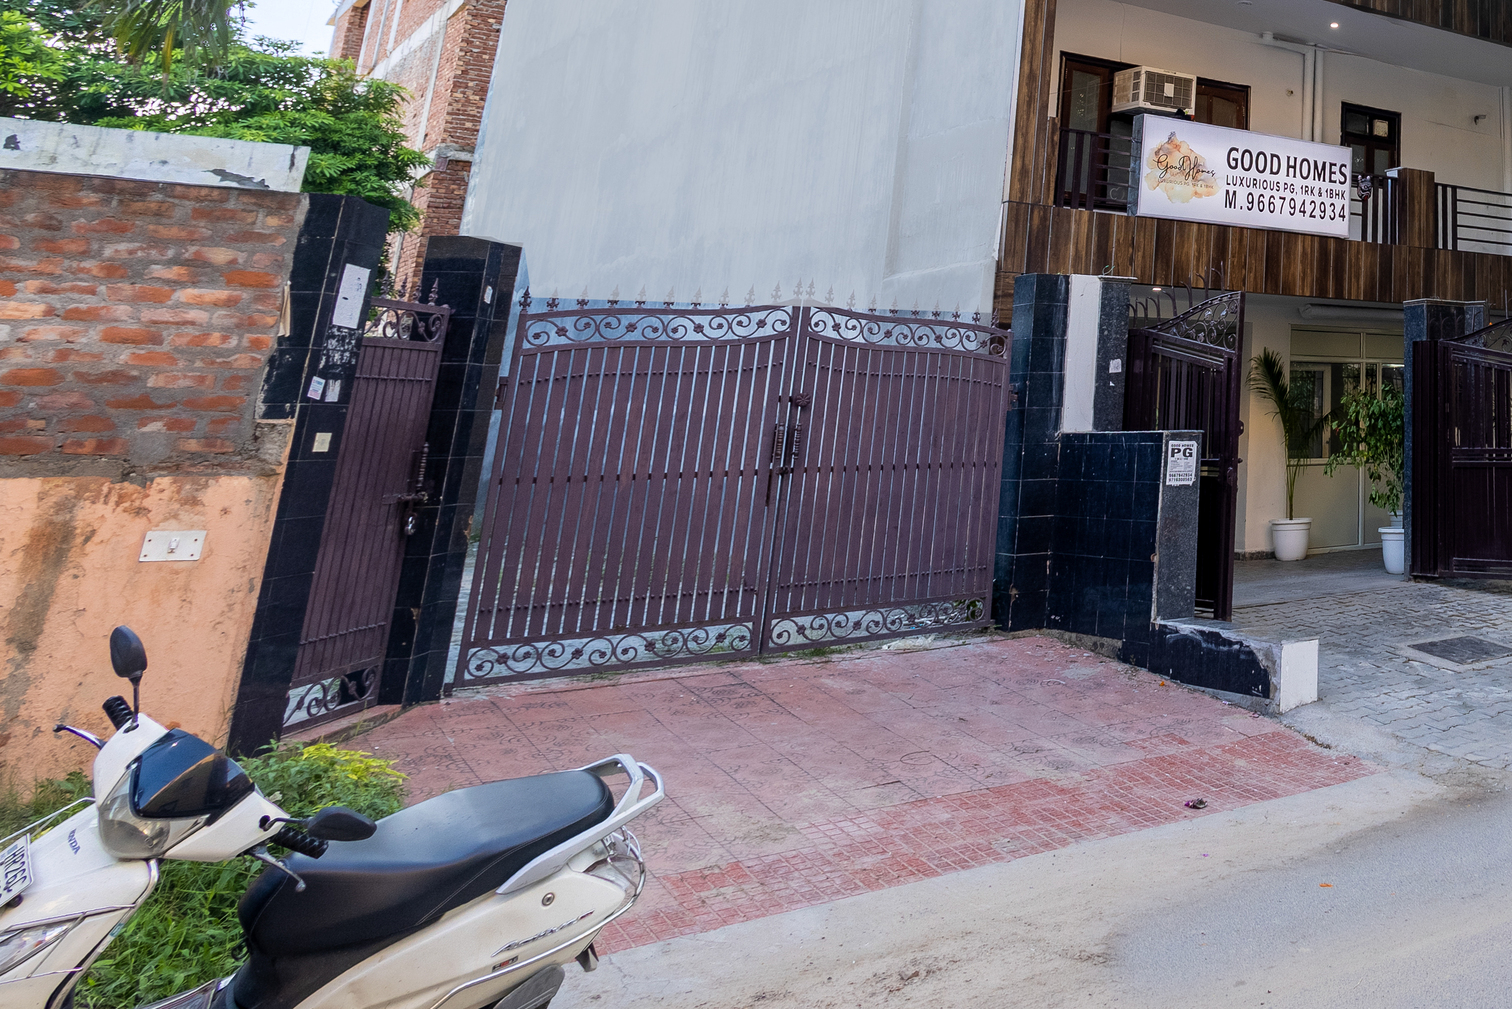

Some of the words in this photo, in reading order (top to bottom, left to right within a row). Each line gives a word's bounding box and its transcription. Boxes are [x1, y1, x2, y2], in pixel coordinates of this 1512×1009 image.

[1226, 147, 1282, 175] GOOD
[1285, 155, 1348, 185] HOMES
[1226, 174, 1281, 192] LUXURIOUS
[1283, 182, 1298, 195] PG,
[1300, 185, 1316, 197] 1RK
[1317, 187, 1323, 198] &
[1325, 188, 1346, 201] 1BHK
[1224, 189, 1346, 222] M.9667942934
[1170, 447, 1193, 458] PG
